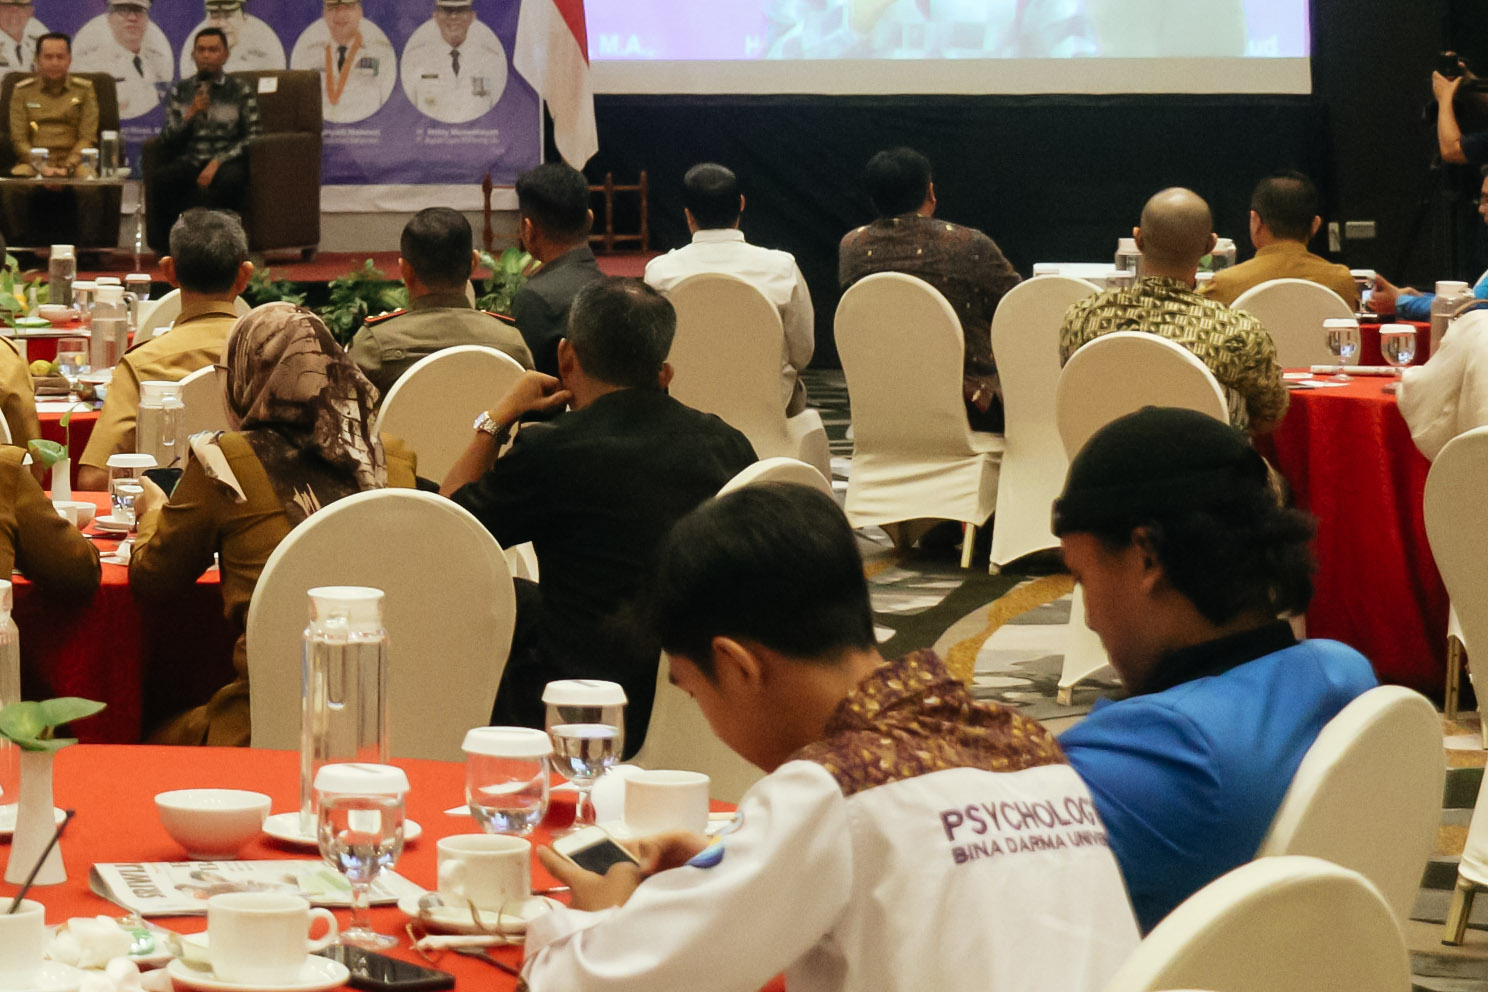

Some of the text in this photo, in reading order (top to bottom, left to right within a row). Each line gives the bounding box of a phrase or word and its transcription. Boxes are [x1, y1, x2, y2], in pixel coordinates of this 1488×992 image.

[940, 795, 1097, 841] PSYCHOLOG
[952, 840, 1002, 865] BINA
[1005, 831, 1067, 854] DARMA
